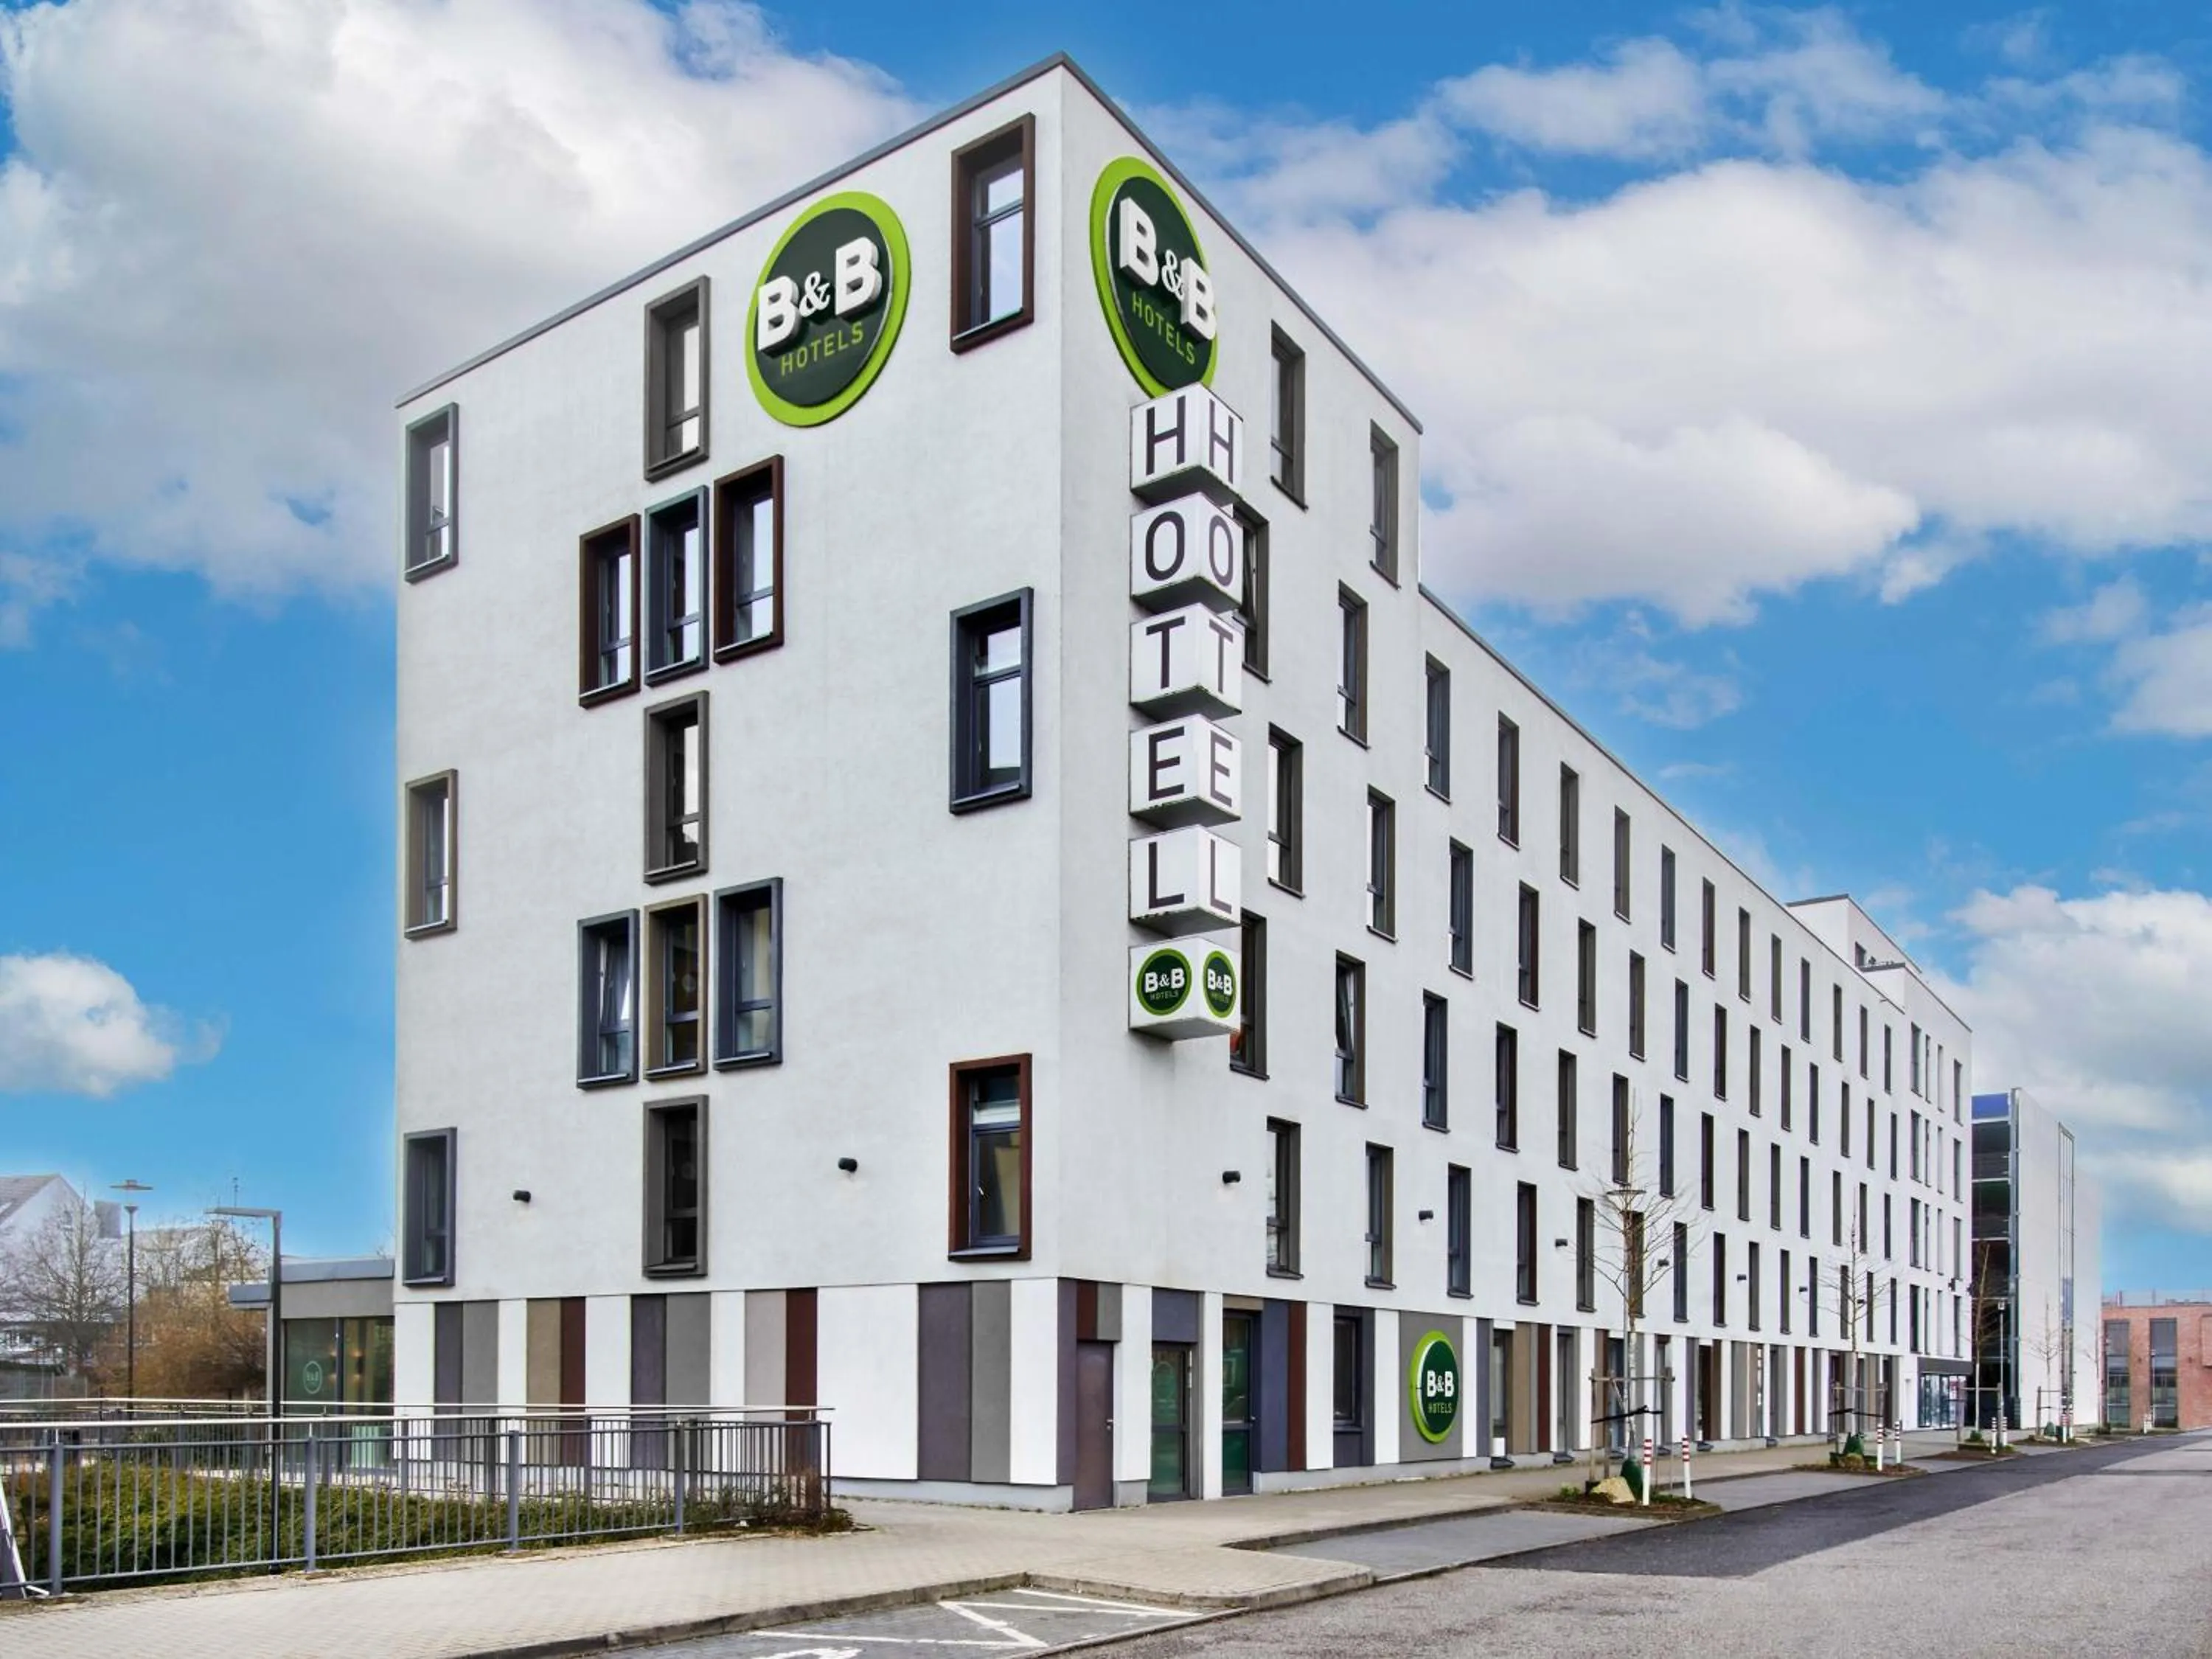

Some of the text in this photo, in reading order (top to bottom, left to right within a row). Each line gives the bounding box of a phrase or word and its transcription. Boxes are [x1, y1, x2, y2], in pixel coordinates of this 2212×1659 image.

[758, 236, 883, 352] B&B
[1119, 197, 1217, 341] B&B
[781, 322, 863, 376] HOTELS
[1132, 292, 1195, 365] HOTELS
[1145, 395, 1186, 909] HOTEL
[1208, 398, 1234, 914] HOTEL
[1144, 967, 1185, 992] B&B
[1207, 968, 1233, 996] B&B
[1427, 1370, 1454, 1397] B&B
